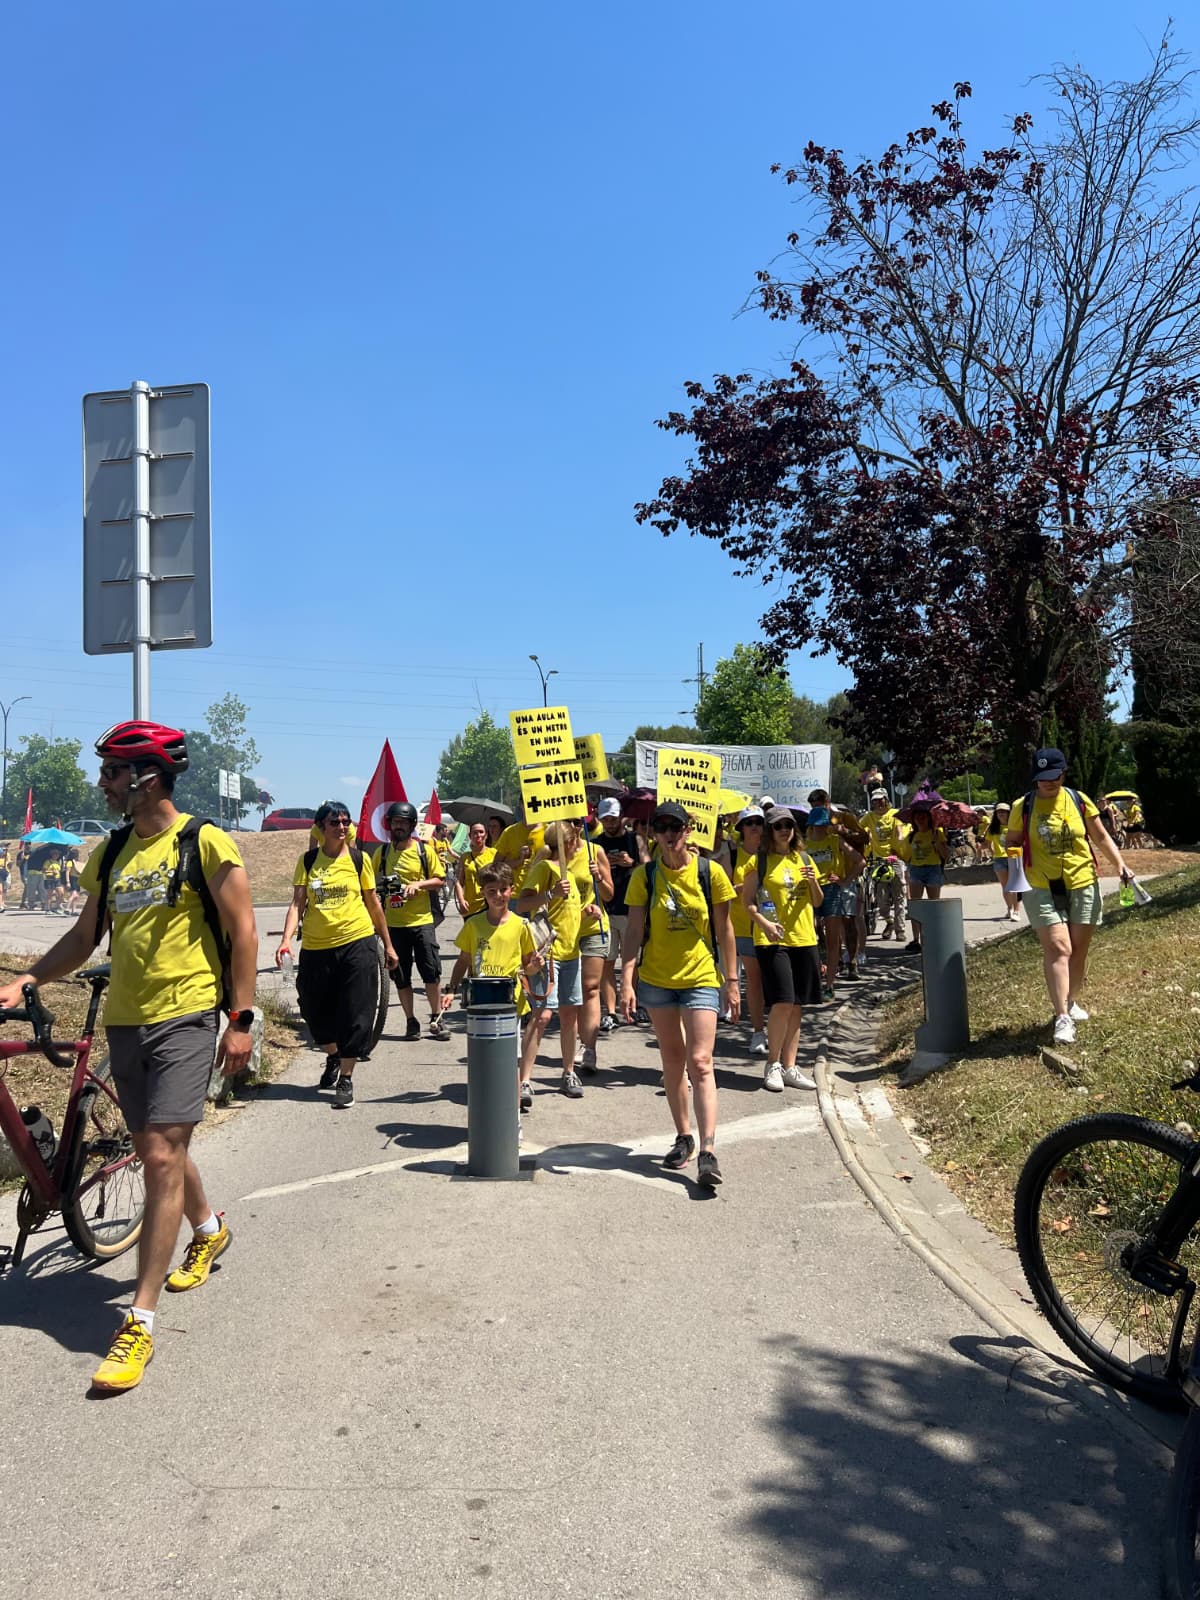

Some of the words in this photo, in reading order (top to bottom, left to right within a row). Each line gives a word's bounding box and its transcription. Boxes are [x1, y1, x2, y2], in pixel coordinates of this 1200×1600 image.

[515, 715, 534, 724] UNA
[537, 712, 555, 721] AULA
[517, 725, 528, 736] ÉS
[531, 726, 542, 734] UN
[529, 737, 541, 746] EN
[544, 735, 562, 744] HORA
[536, 746, 560, 757] PUNTA
[674, 757, 695, 766] AMB
[699, 760, 710, 769] 27
[545, 769, 580, 786] RÀTIO
[663, 768, 708, 781] ALUMNES
[711, 776, 716, 784] A
[676, 780, 706, 794] L'AULA
[543, 794, 584, 808] MESTRES
